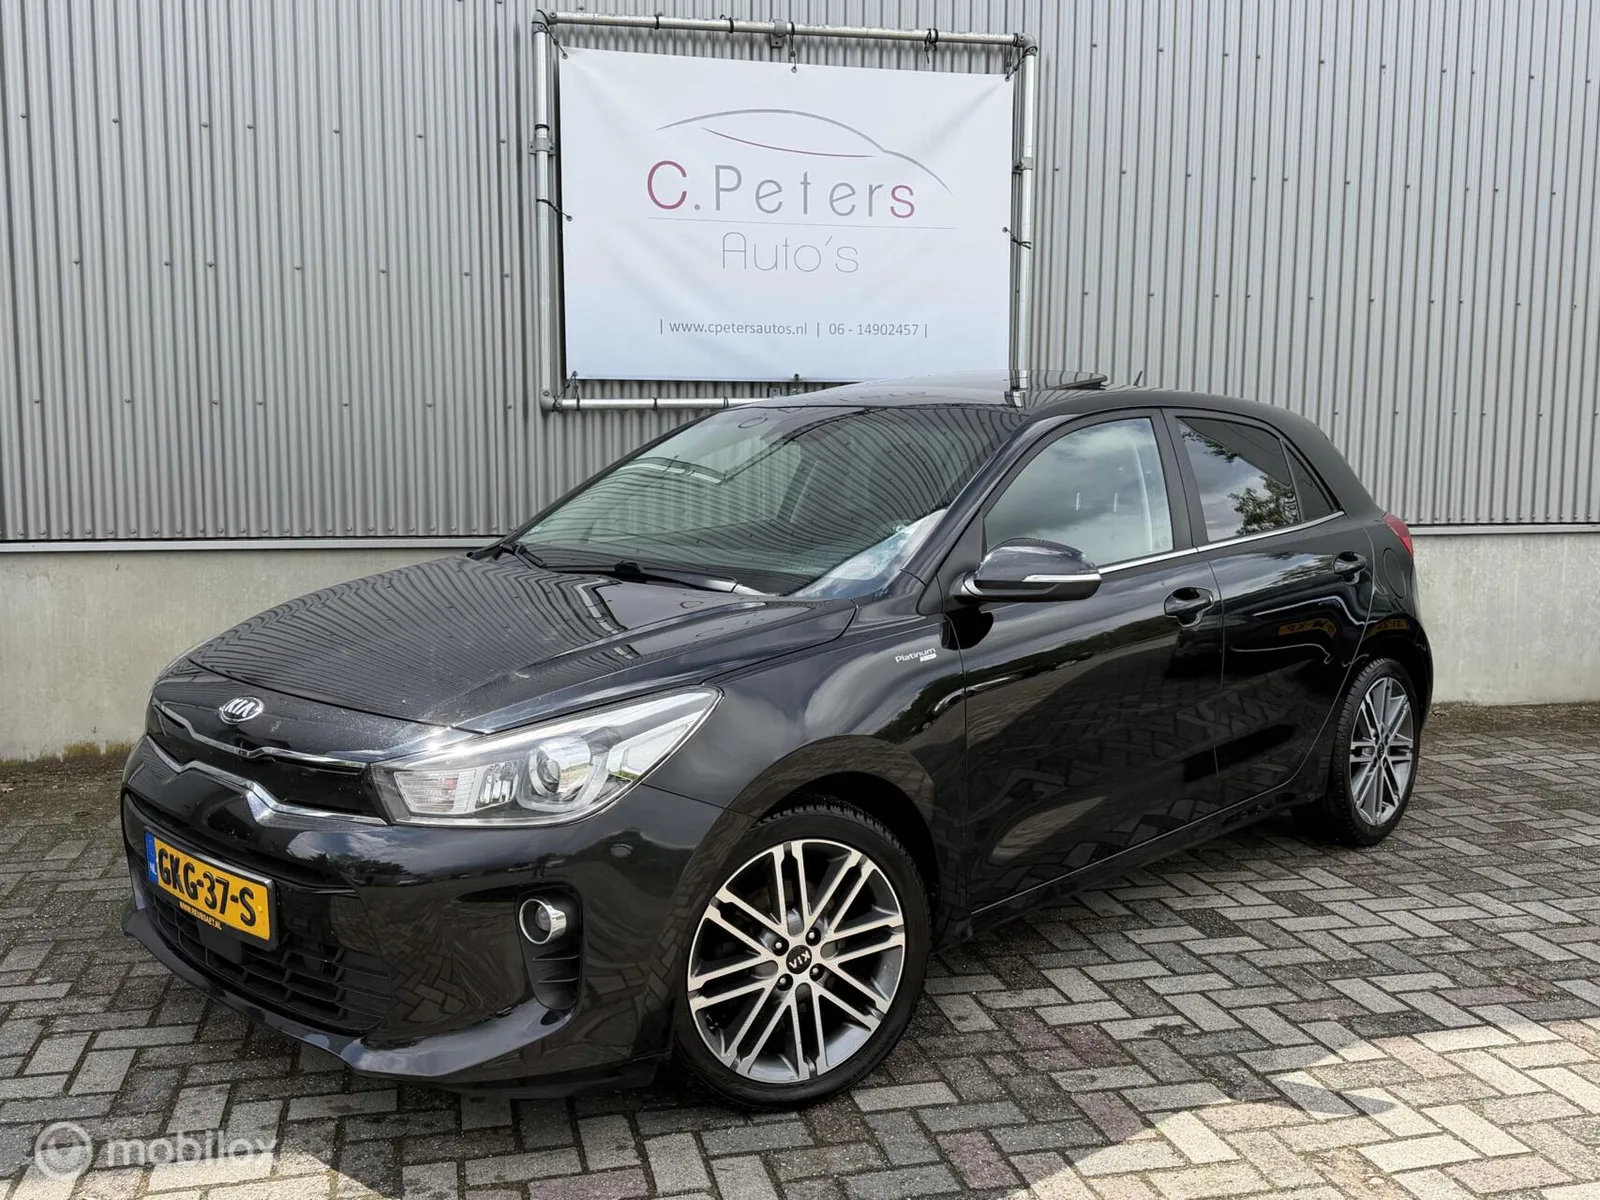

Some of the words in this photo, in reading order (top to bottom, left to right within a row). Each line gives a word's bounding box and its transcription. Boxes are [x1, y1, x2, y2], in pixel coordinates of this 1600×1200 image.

[722, 231, 859, 274] Auto's
[669, 321, 808, 336] www.cpetersautos.nl
[828, 322, 845, 336] 06
[857, 322, 919, 337] 14902457
[894, 647, 936, 663] Platinum
[224, 698, 255, 718] KIA
[158, 847, 256, 927] GKG-37-S
[788, 950, 811, 969] KIA
